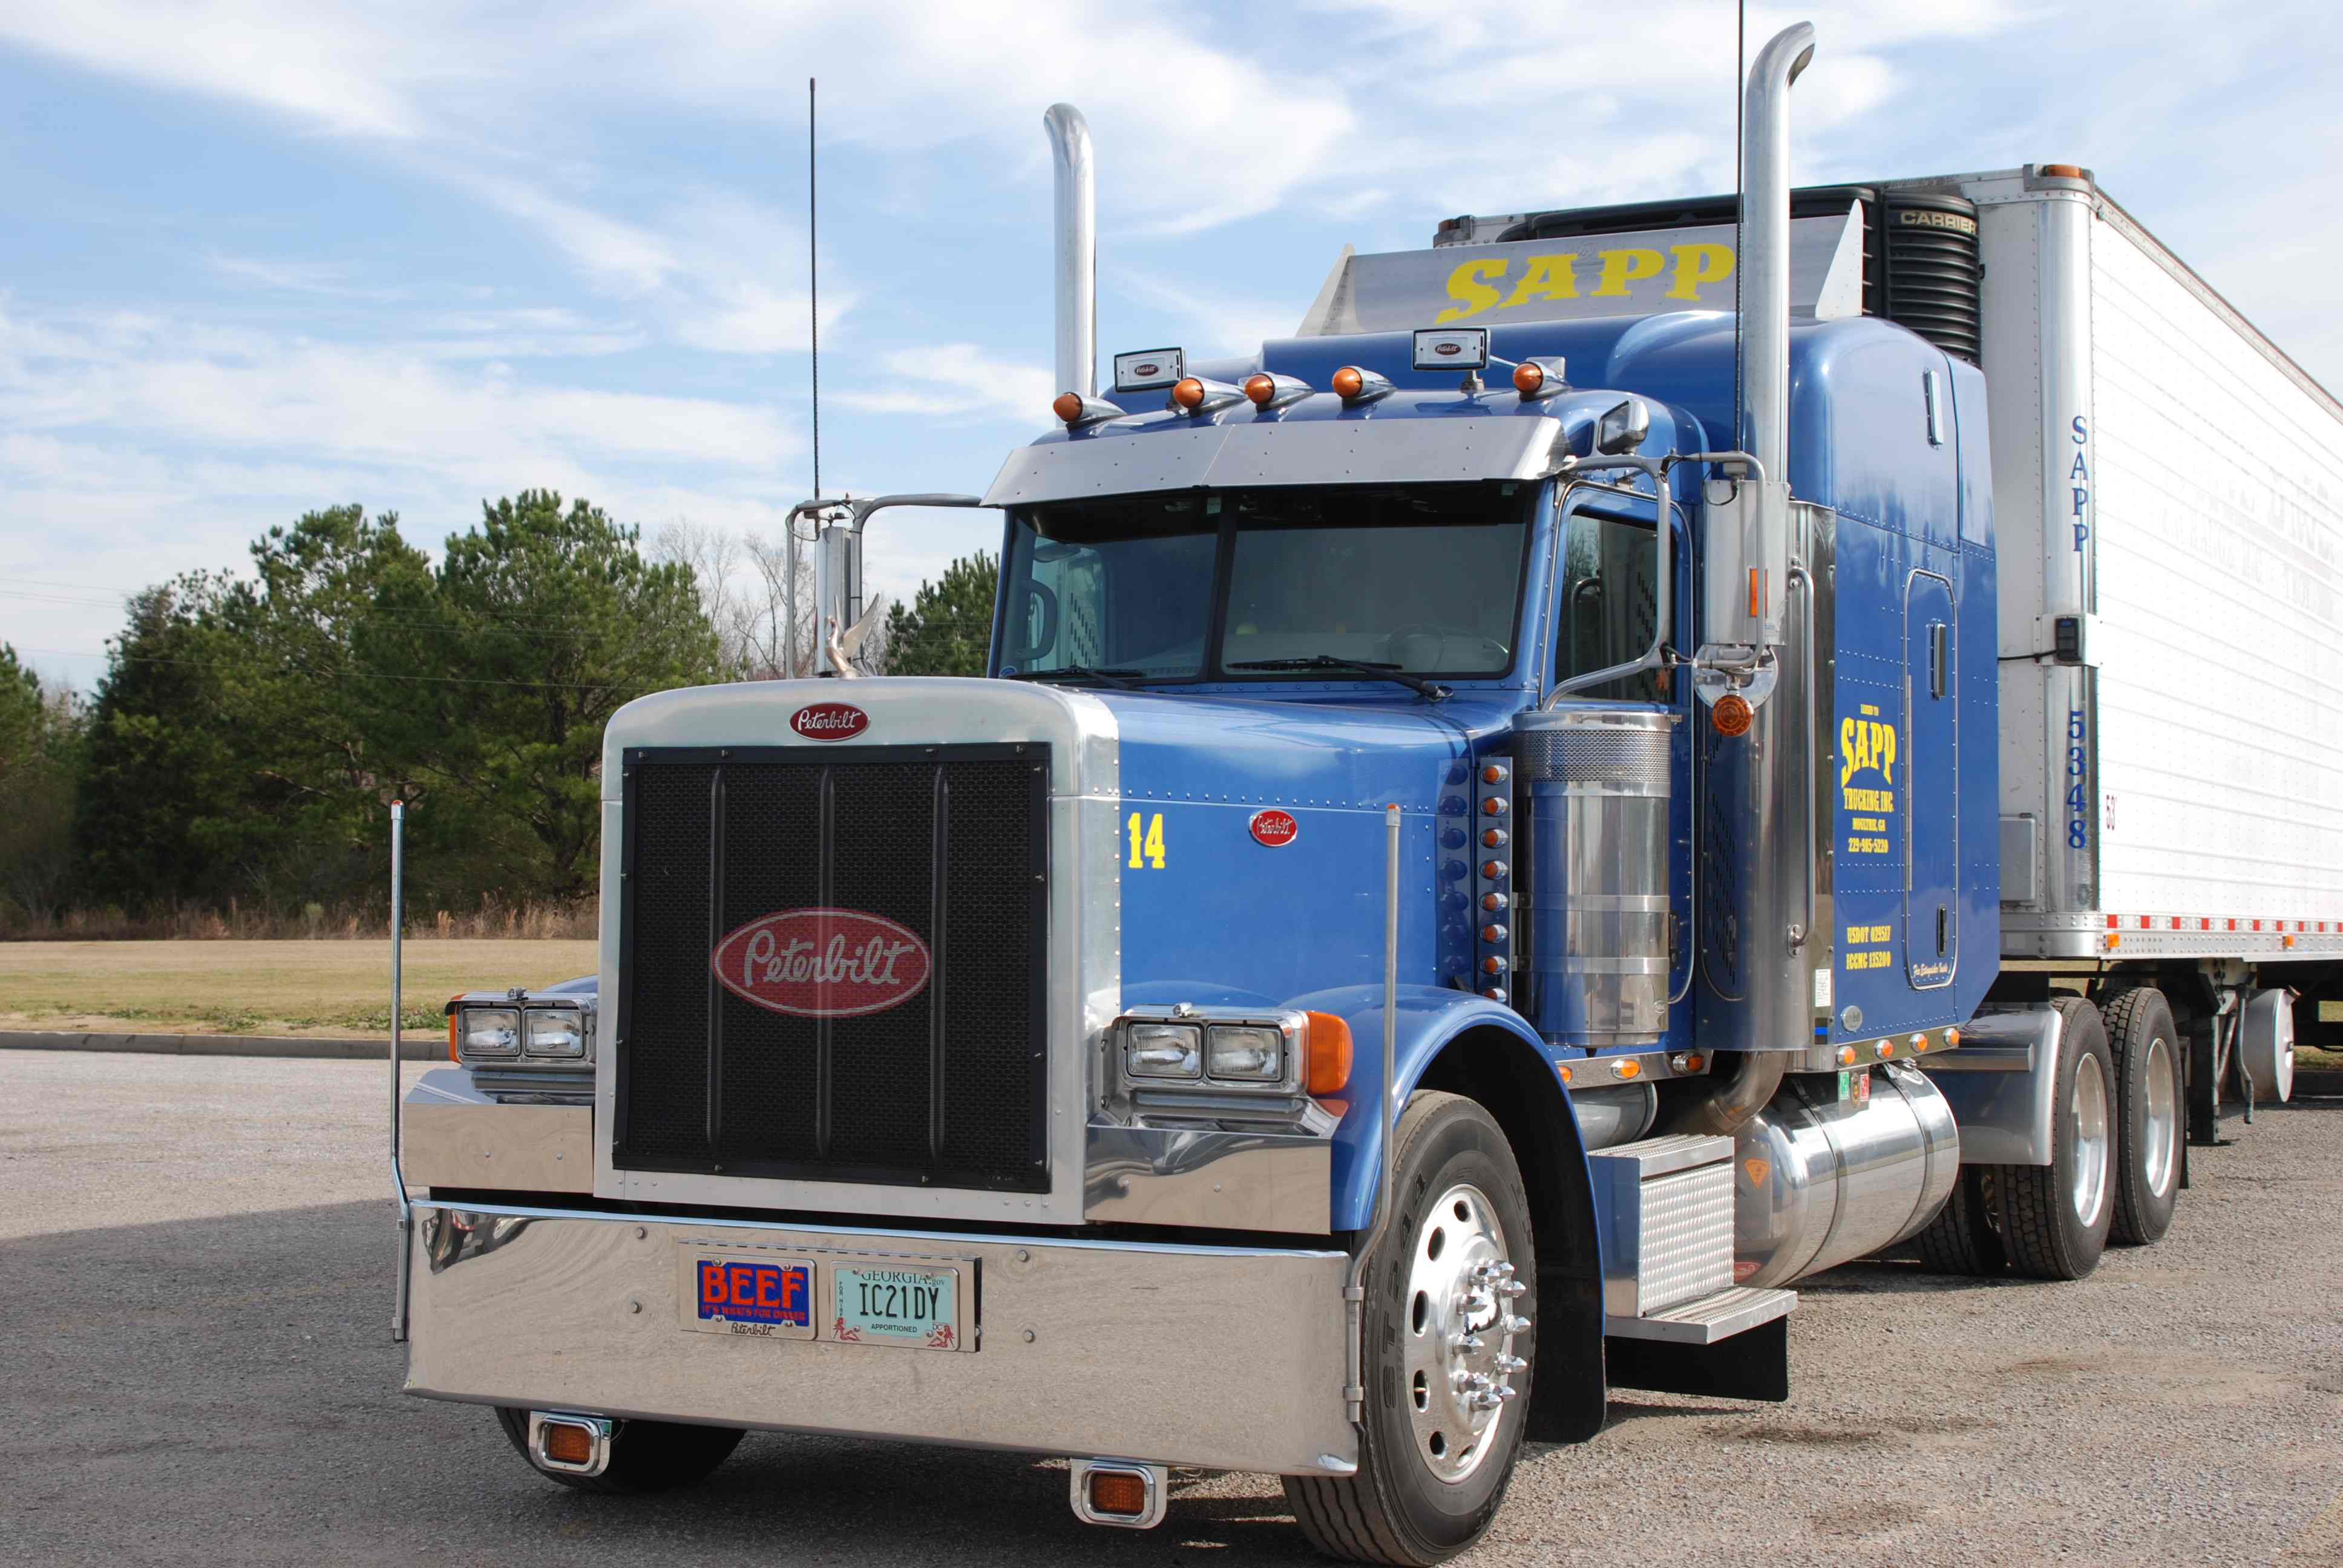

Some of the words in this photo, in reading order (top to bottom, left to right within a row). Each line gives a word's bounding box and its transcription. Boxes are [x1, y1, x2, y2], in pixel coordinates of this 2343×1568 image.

[1900, 211, 1977, 235] CARRIER
[1434, 243, 1736, 325] SAPP
[2069, 415, 2089, 551] SAPP
[798, 710, 861, 731] Peterbilt
[1841, 717, 1896, 788] SAPP
[2066, 711, 2086, 849] 5348
[1128, 812, 1165, 869] 14
[744, 930, 916, 988] Peterbilt
[702, 1265, 805, 1308] BEEF
[731, 1322, 776, 1336] Peterbilt
[871, 1323, 917, 1333] APPORTIONED
